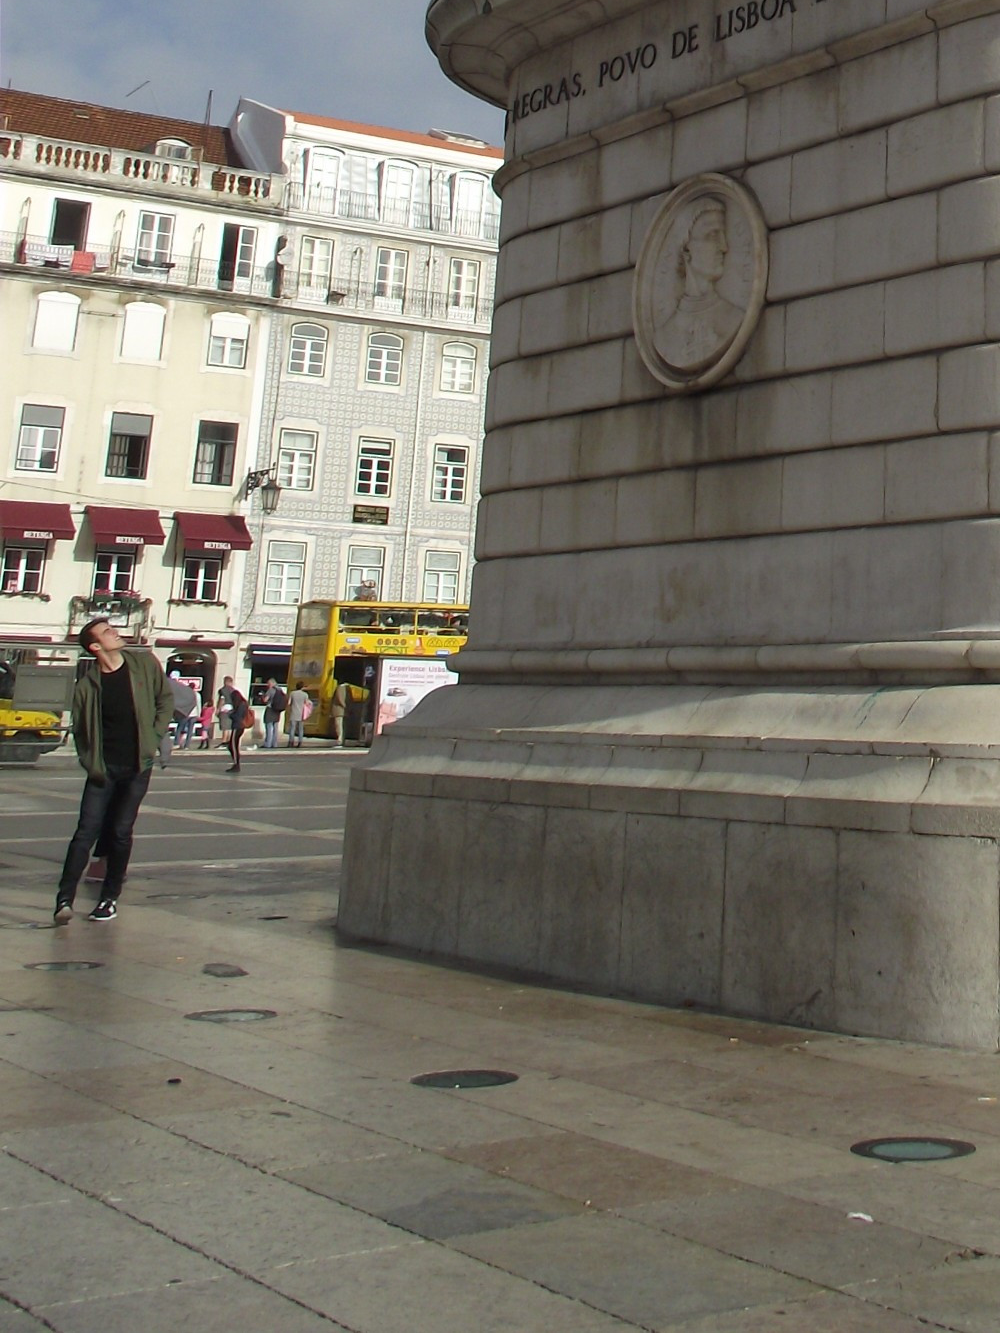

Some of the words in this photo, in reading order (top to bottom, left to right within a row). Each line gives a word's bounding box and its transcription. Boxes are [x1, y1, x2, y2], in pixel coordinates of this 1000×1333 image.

[598, 43, 657, 88] POVO
[671, 23, 700, 60] DE
[389, 665, 426, 673] Experience
